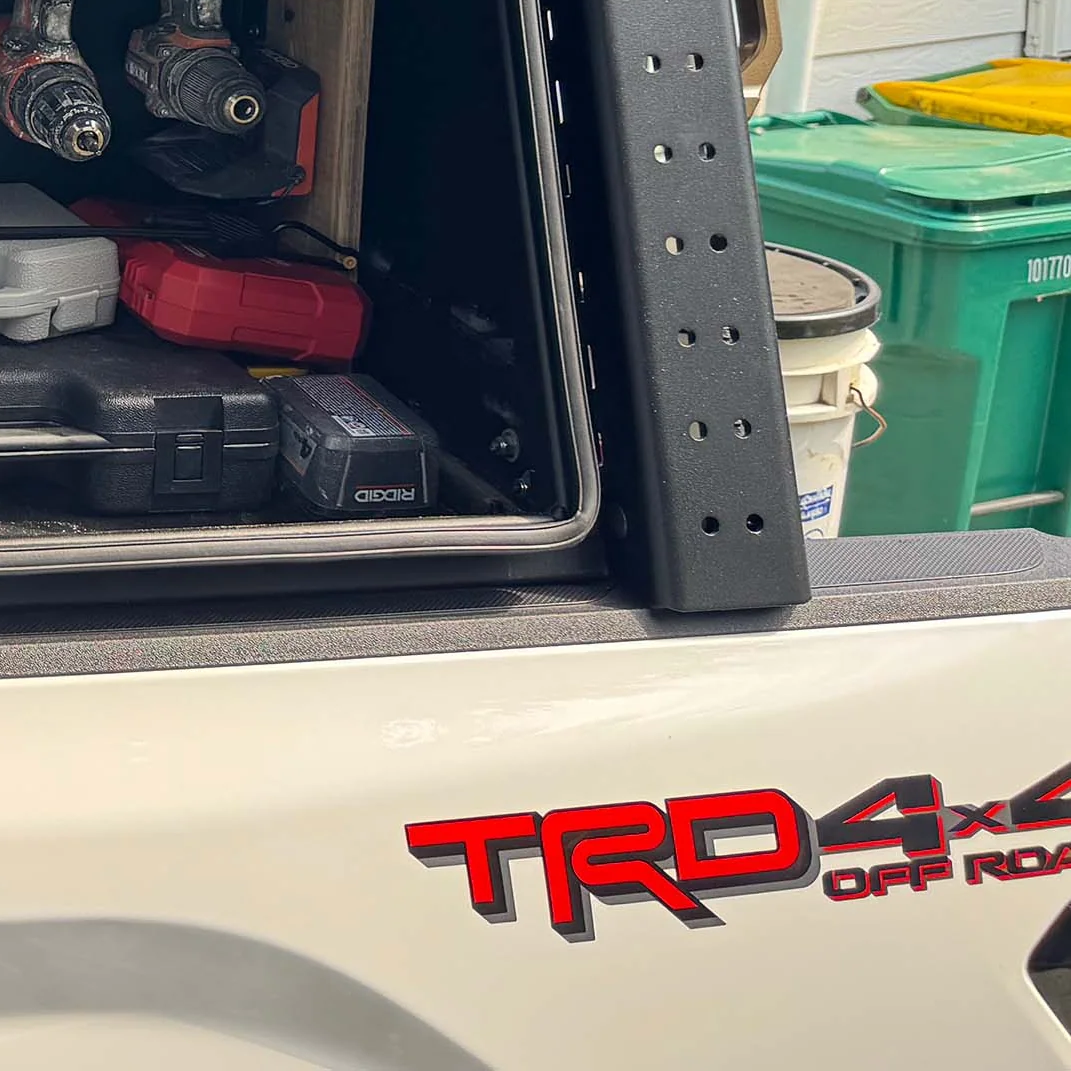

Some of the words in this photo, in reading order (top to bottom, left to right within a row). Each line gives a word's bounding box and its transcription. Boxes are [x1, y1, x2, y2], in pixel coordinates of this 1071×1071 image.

[354, 487, 415, 504] RIDGID
[404, 788, 820, 944] TRD
[822, 855, 953, 902] OFF
